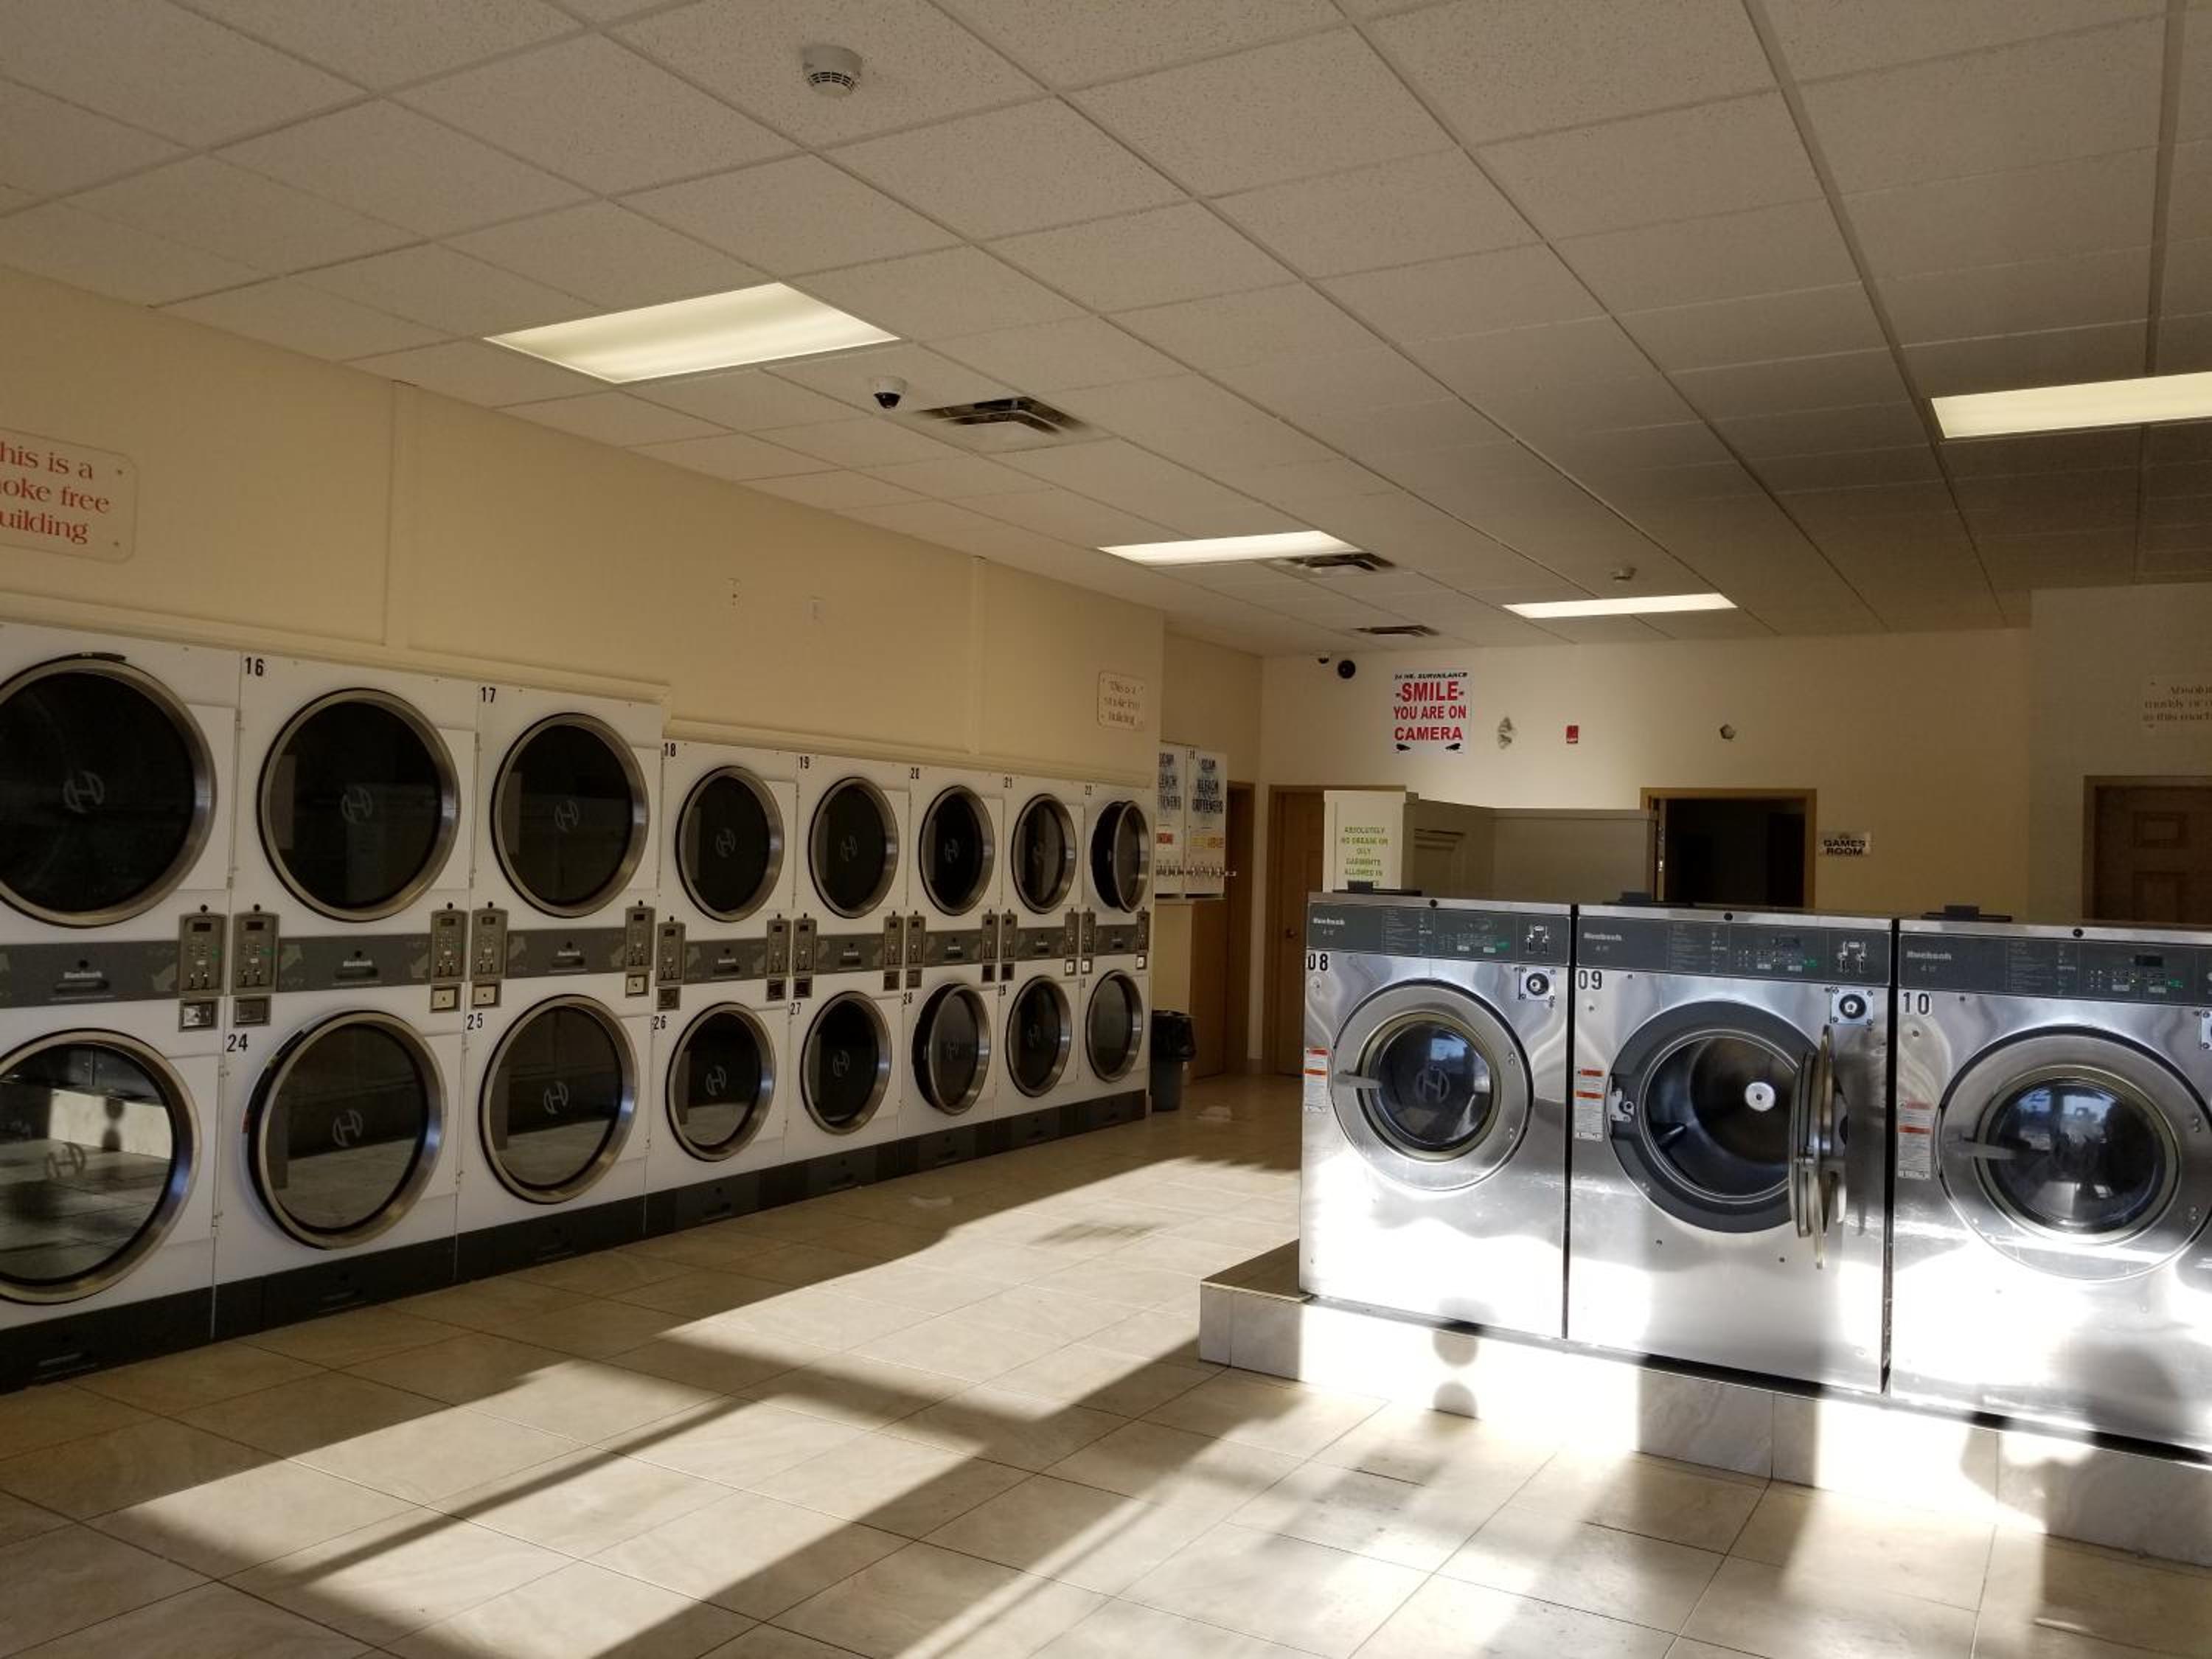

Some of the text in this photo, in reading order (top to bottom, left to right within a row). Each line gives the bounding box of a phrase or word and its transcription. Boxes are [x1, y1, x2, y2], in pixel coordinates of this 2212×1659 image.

[48, 451, 69, 474] is
[78, 462, 93, 479] a
[0, 478, 110, 514] oke free
[245, 657, 264, 676] 16
[481, 686, 496, 703] 17
[1394, 705, 1467, 720] YOU ARE ON
[1394, 726, 1463, 741] CAMERA
[664, 743, 676, 757] 18
[1823, 840, 1865, 848] GAMES
[1826, 848, 1863, 856] ROOM
[1308, 954, 1329, 971] 08
[1579, 970, 1603, 990] 09
[790, 1001, 801, 1015] 27
[1903, 992, 1931, 1015] 10
[467, 1012, 484, 1030] 25
[653, 1015, 666, 1030] 26
[226, 1034, 248, 1051] 24
